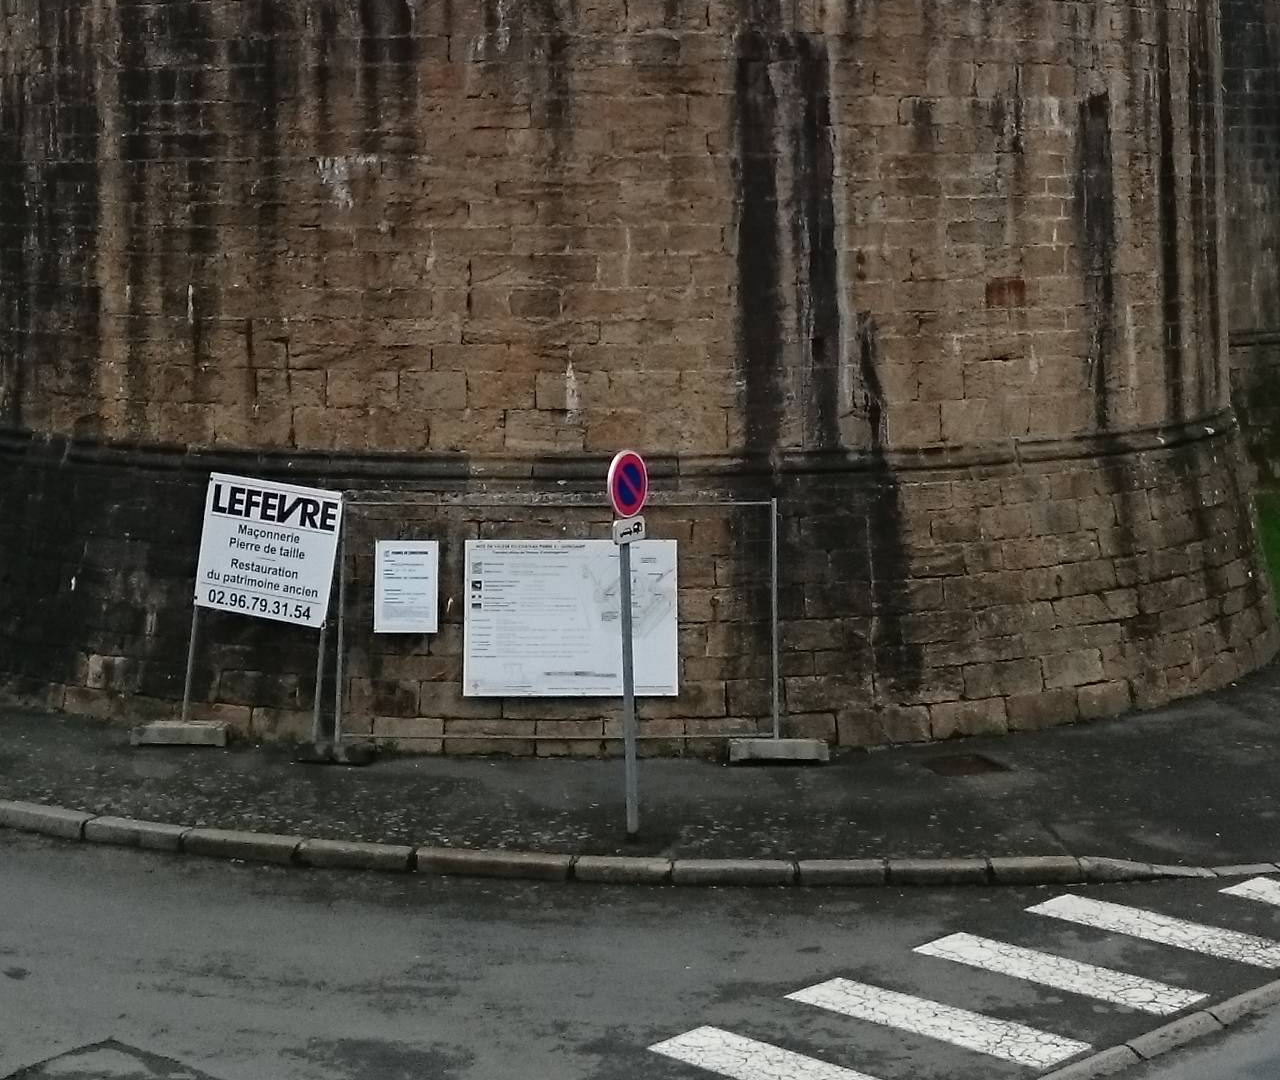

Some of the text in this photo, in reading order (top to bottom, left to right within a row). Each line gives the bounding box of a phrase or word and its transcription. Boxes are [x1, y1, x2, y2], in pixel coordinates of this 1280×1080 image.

[211, 483, 339, 532] LEFEVRE
[237, 524, 300, 544] Maçonnerie
[229, 537, 305, 560] Pierre de taille
[230, 558, 298, 580] Restauration
[206, 569, 318, 598] du patrimoine ancien
[208, 589, 312, 621] 02.96.79.31.54
